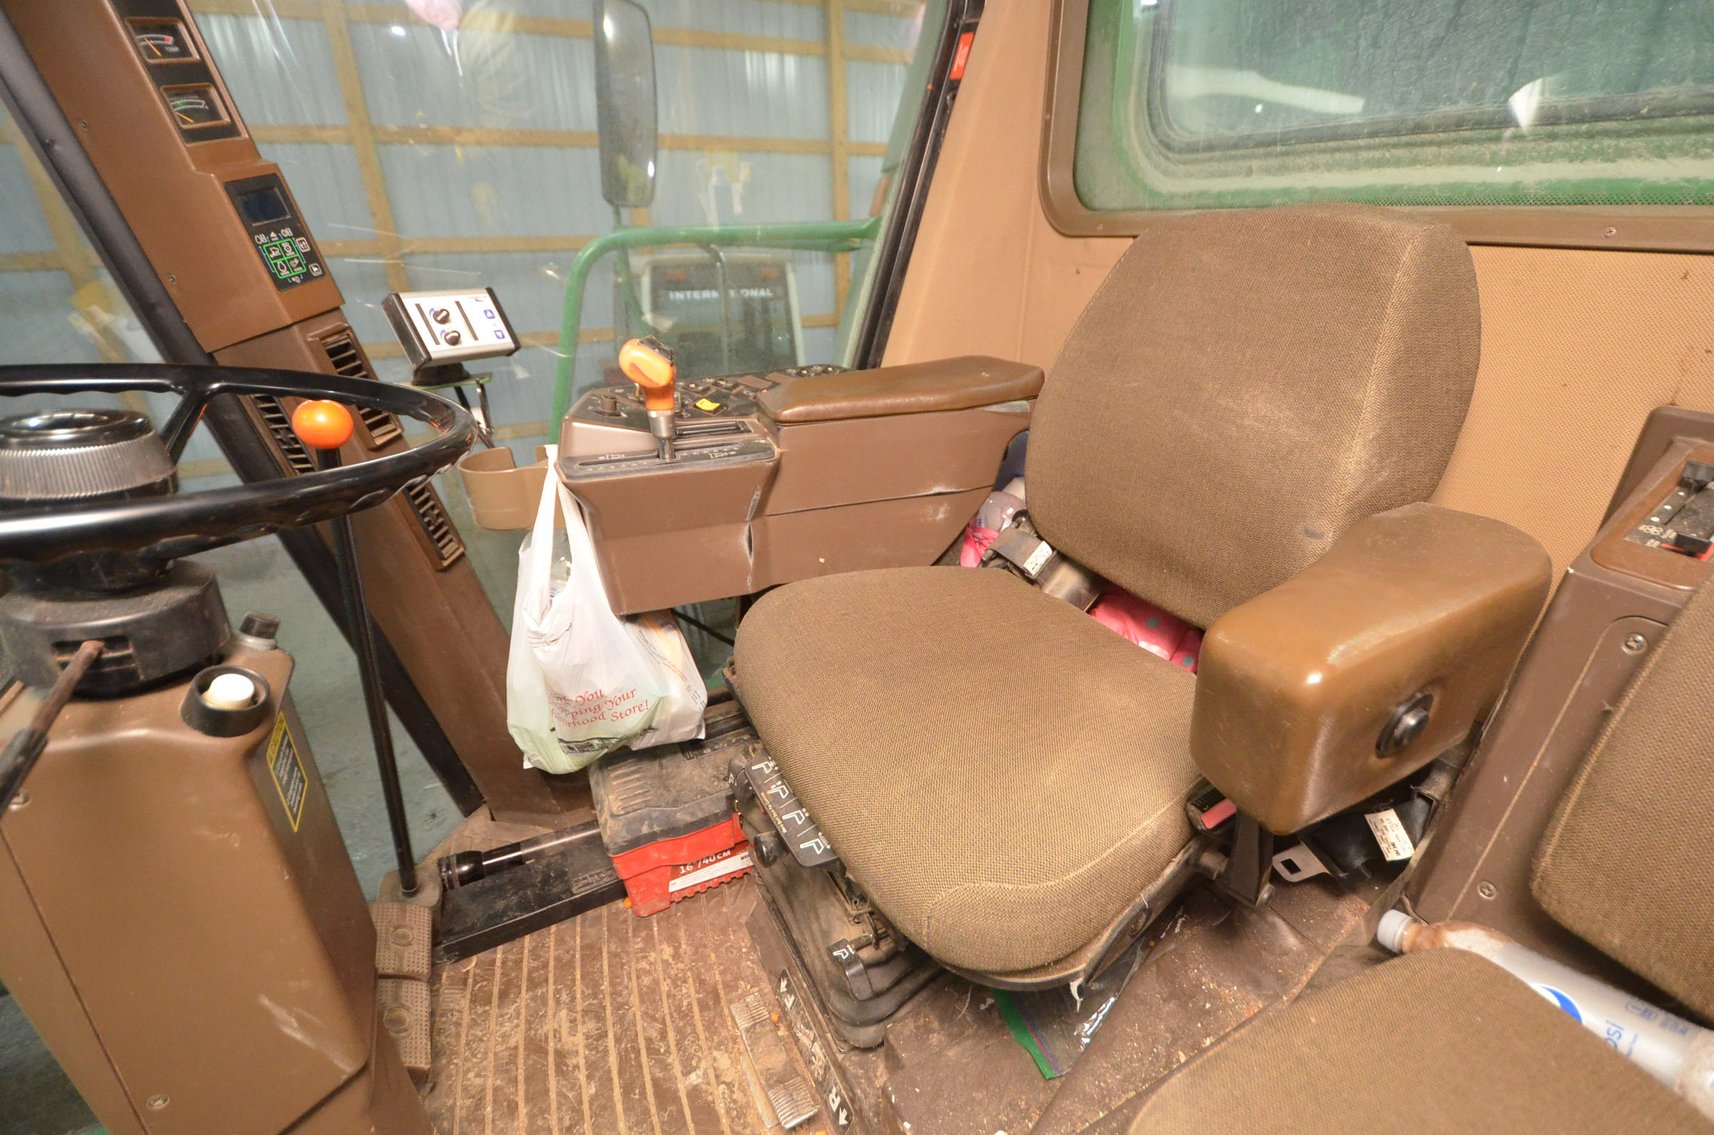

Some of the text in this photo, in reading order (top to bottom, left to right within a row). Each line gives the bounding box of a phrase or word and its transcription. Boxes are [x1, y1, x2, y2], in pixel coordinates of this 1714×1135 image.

[574, 689, 605, 706] You
[604, 687, 638, 711] Your
[610, 699, 650, 722] Store!
